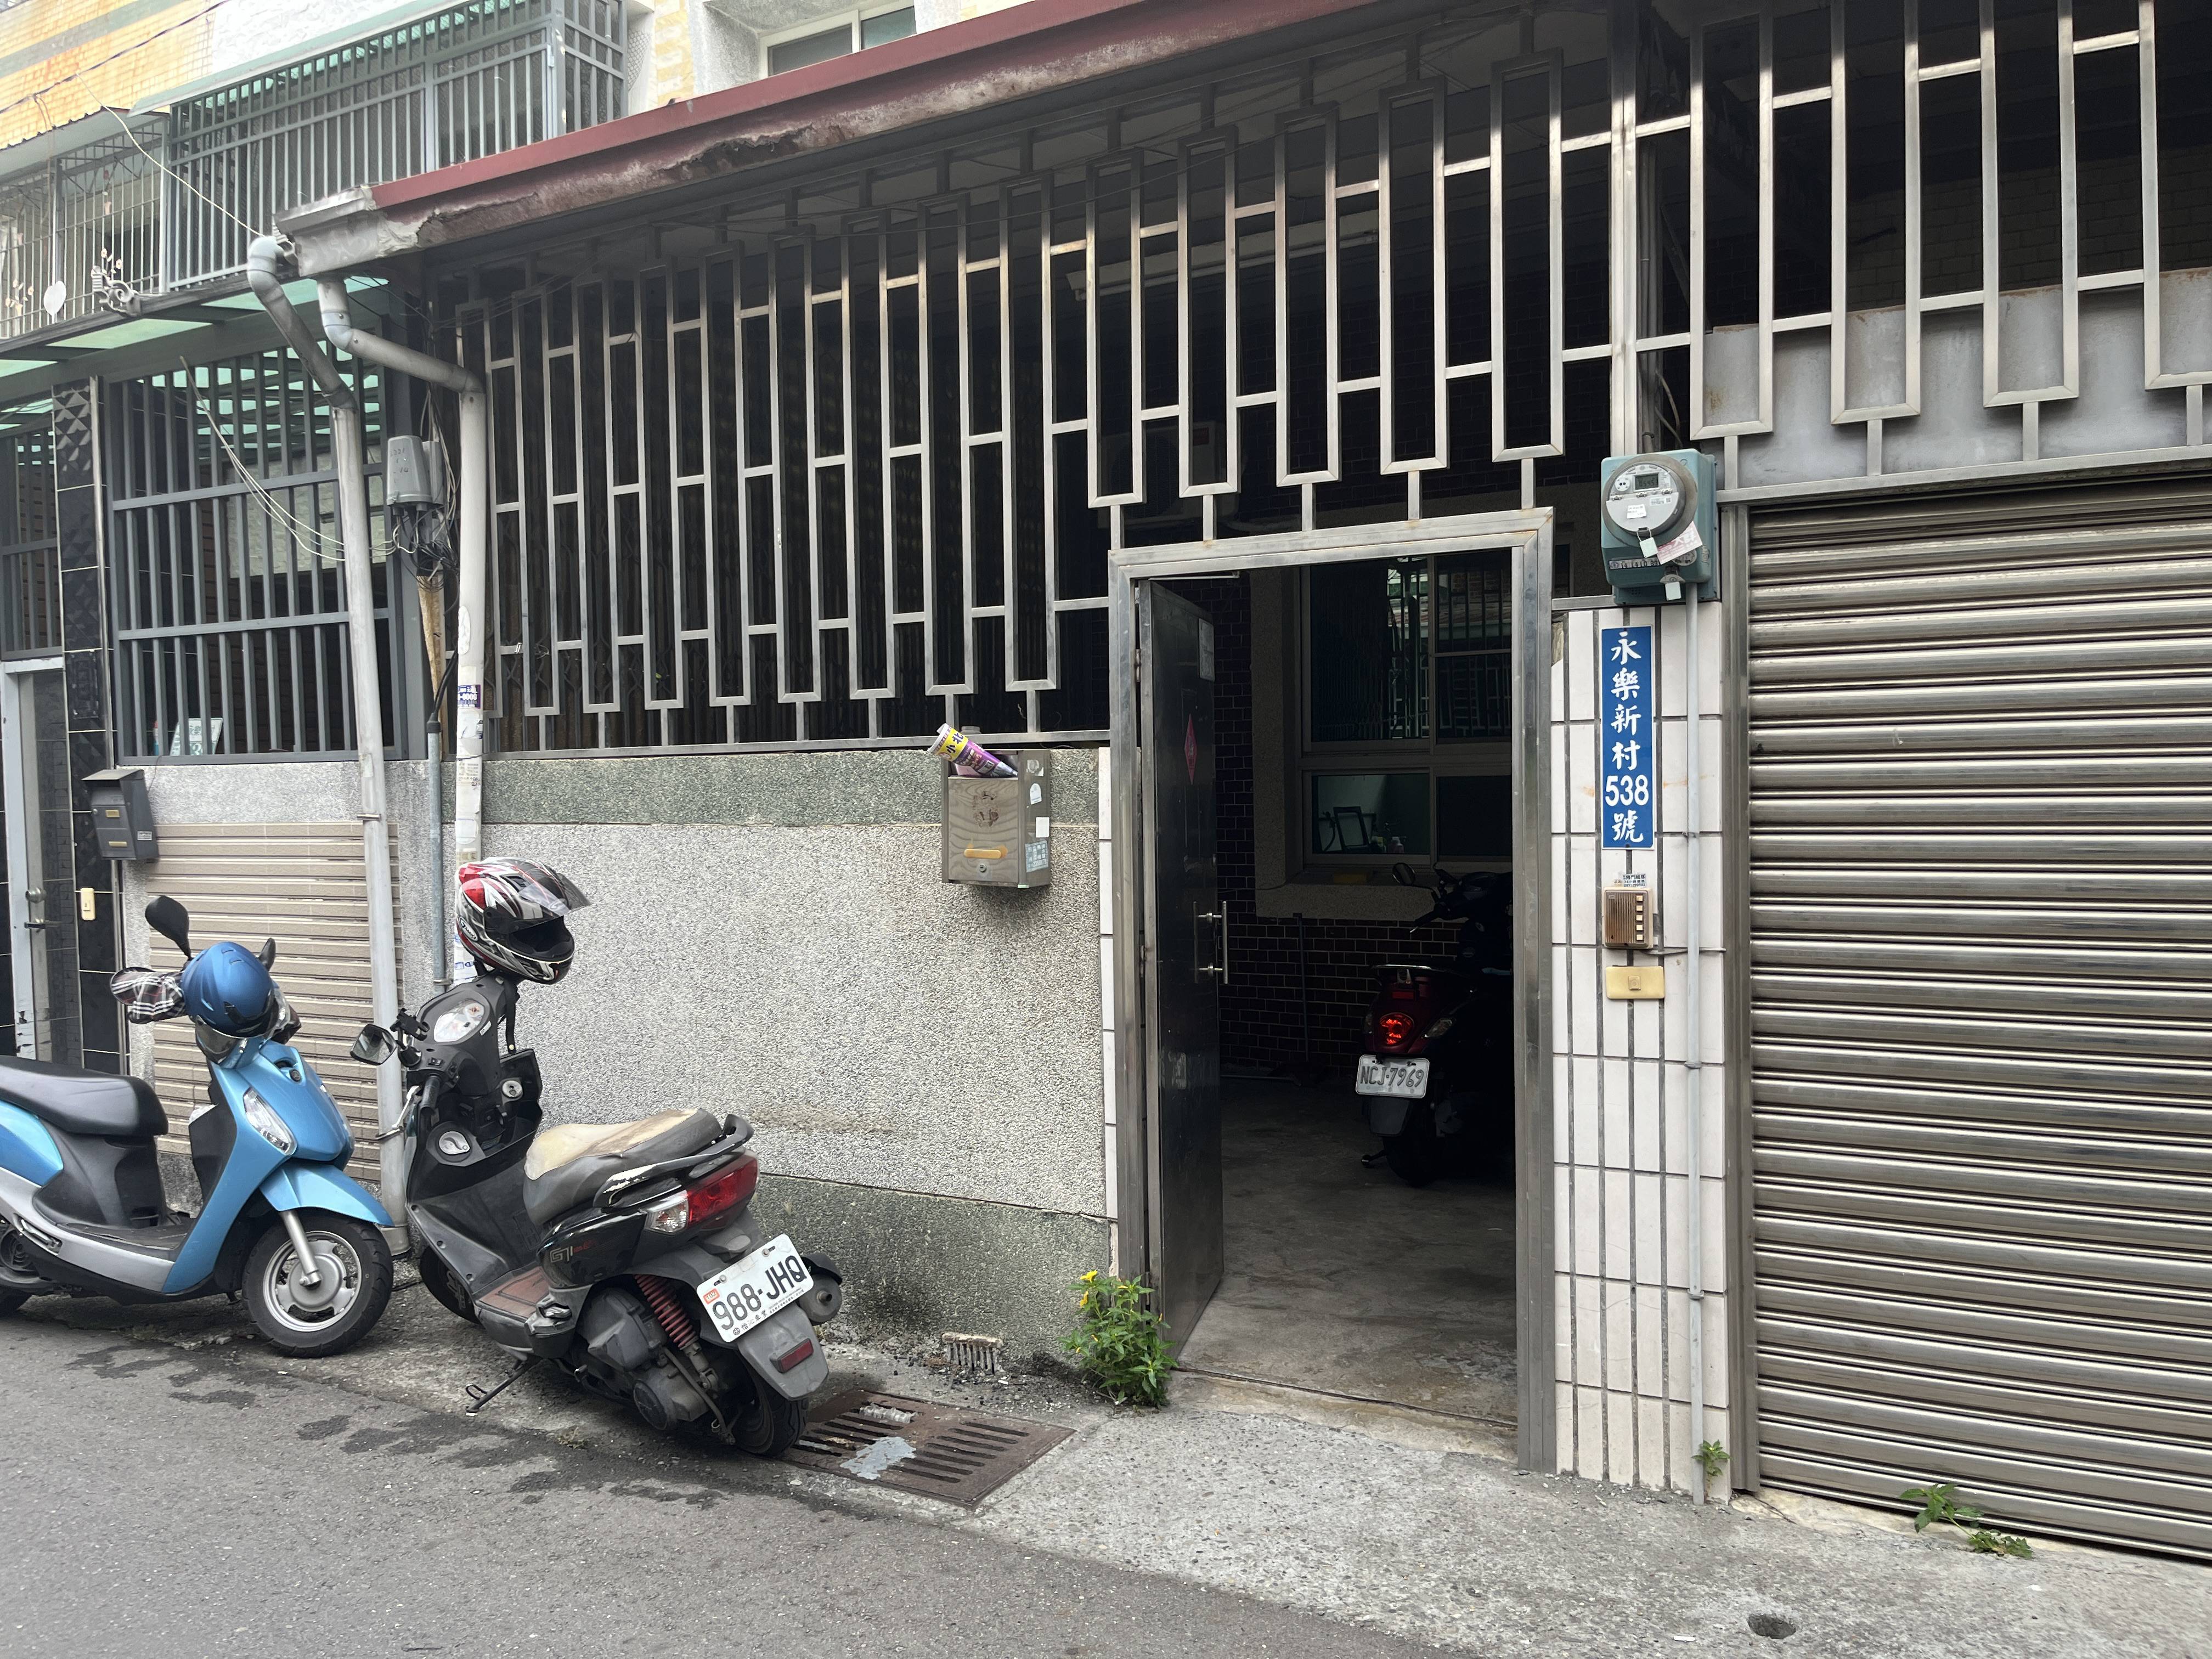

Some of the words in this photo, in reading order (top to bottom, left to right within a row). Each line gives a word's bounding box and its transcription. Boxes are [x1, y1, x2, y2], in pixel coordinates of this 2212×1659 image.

[1605, 630, 1649, 843] 永樂新村538號
[1360, 1065, 1424, 1087] NCJ-7969
[712, 1255, 808, 1330] 988-JHQ
